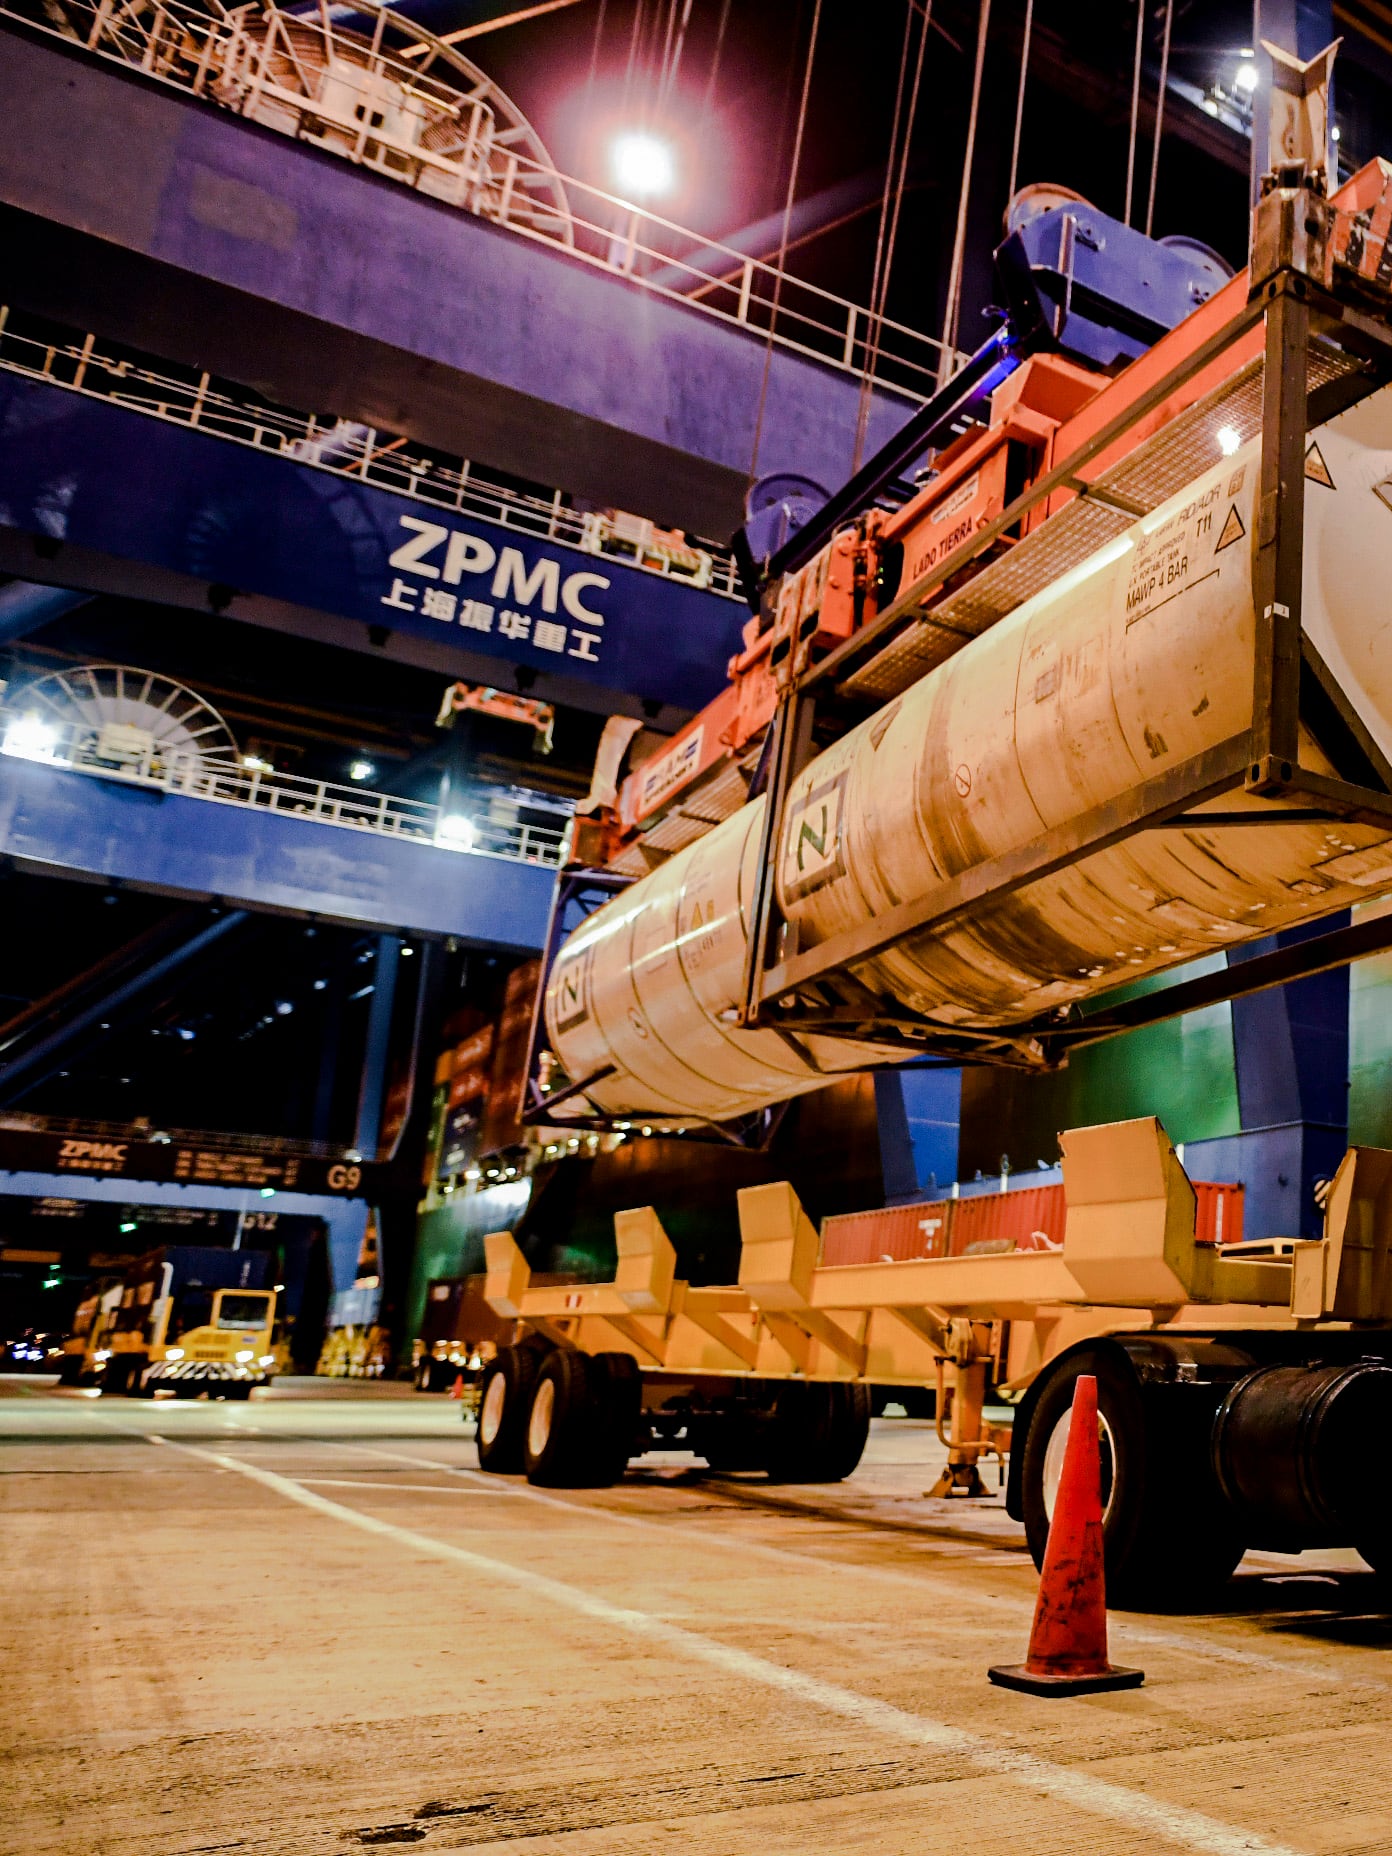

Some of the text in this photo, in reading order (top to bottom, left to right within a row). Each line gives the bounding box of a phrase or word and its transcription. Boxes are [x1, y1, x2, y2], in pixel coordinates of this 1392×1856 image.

[1196, 512, 1212, 538] T11
[913, 516, 973, 580] LADO TIERRA
[389, 514, 611, 626] ZPMC
[1126, 577, 1155, 612] MAWP
[1167, 556, 1188, 585] BAR
[59, 1139, 129, 1162] ZPMC
[327, 1164, 361, 1190] G9
